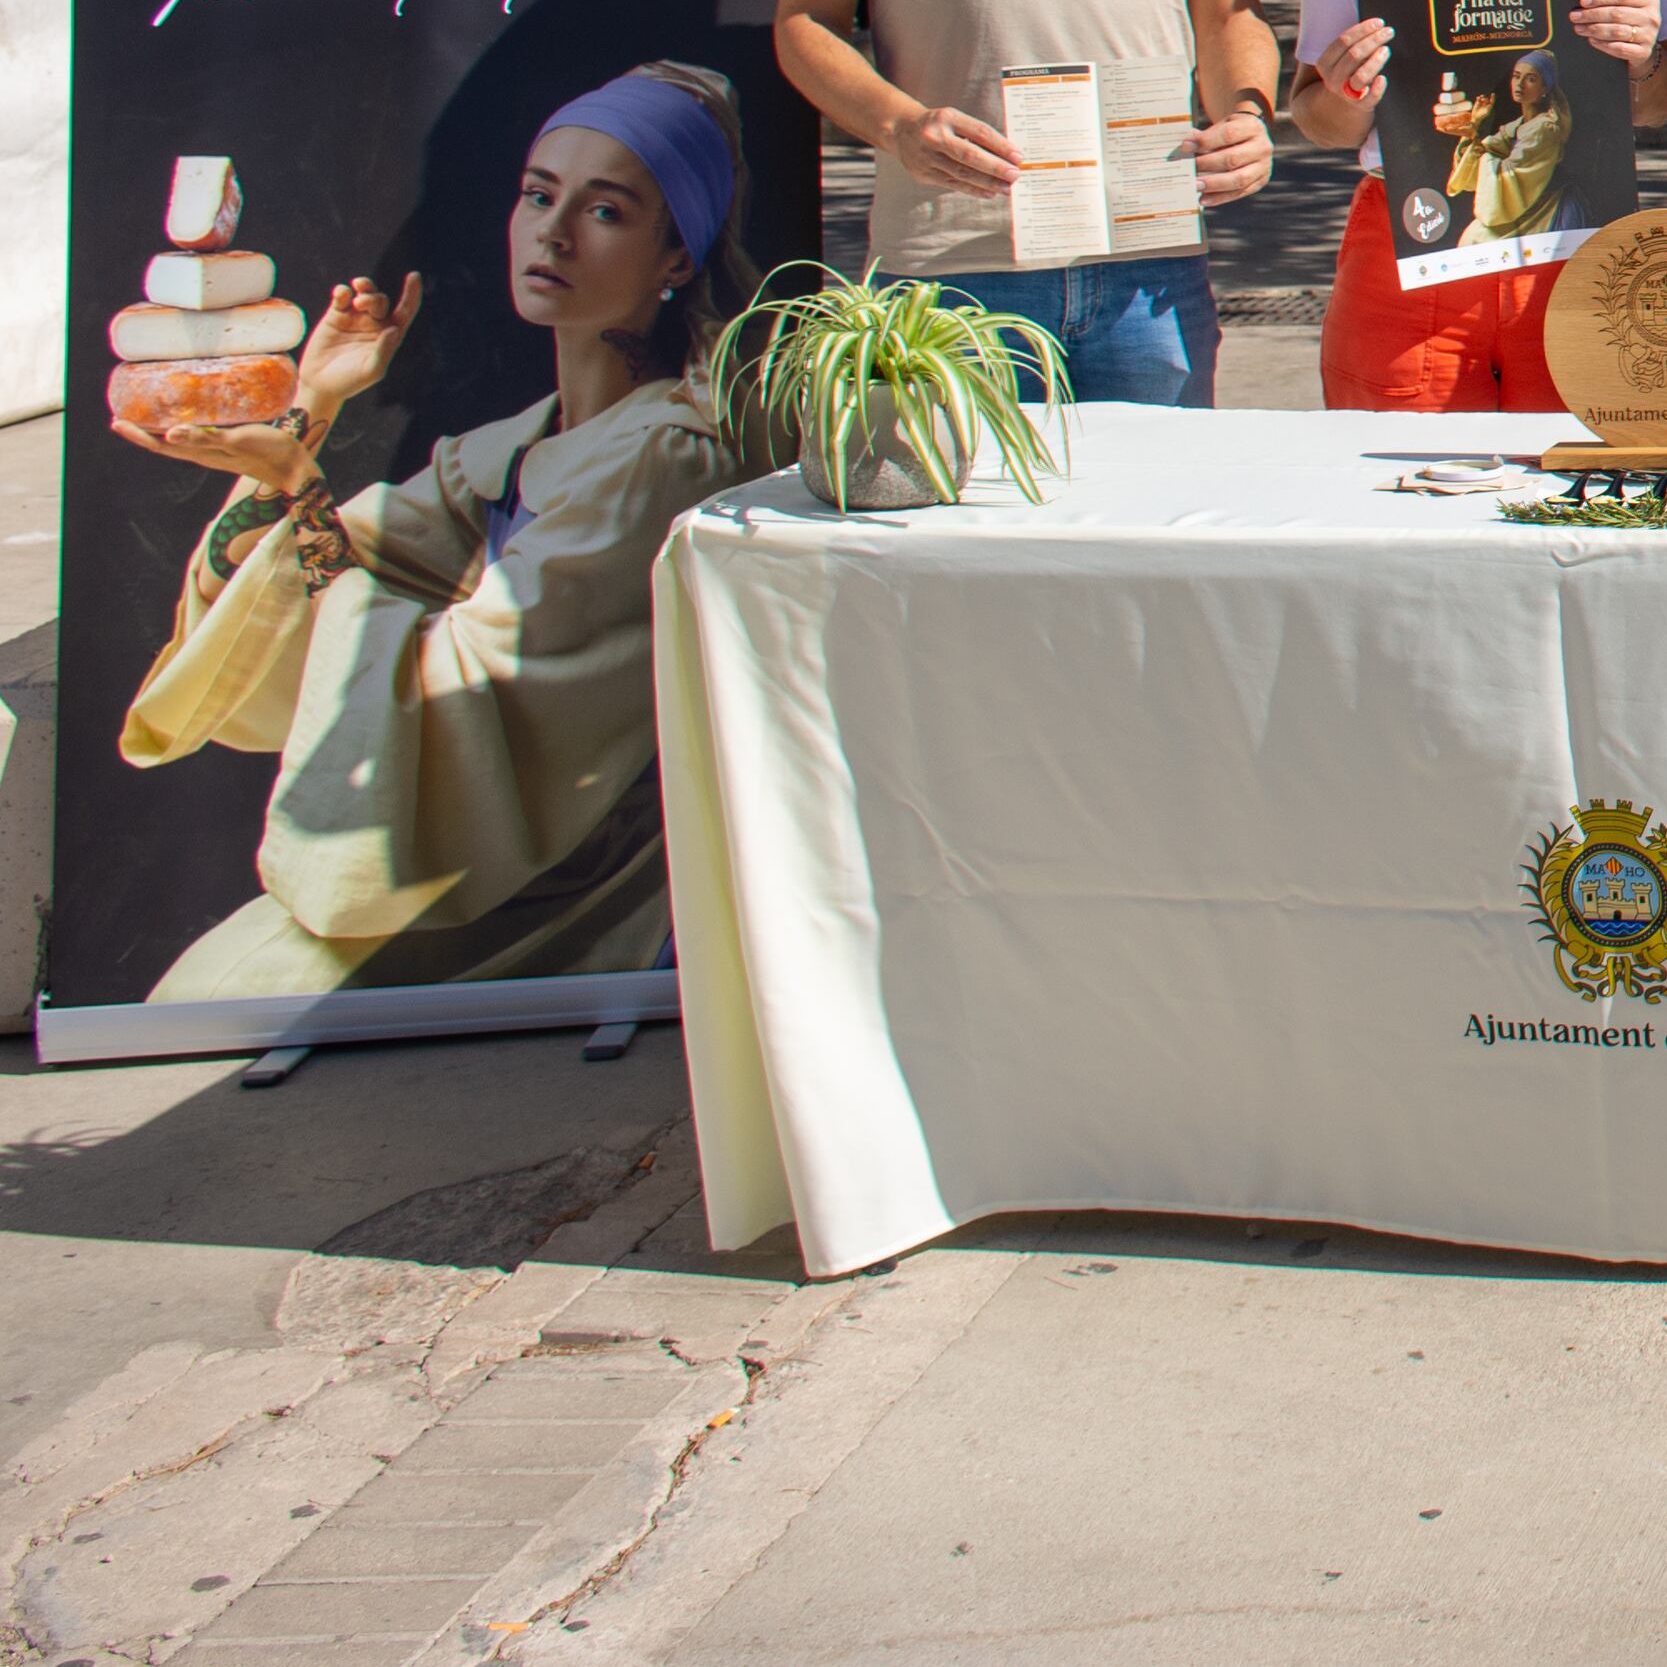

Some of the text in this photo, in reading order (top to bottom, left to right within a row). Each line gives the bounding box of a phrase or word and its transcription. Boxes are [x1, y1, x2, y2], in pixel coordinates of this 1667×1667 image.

[1451, 6, 1534, 32] formatge
[1417, 212, 1445, 239] Edició
[1646, 279, 1661, 289] MA
[1585, 864, 1646, 878] MA HO
[1464, 1014, 1656, 1047] Ajuntament
